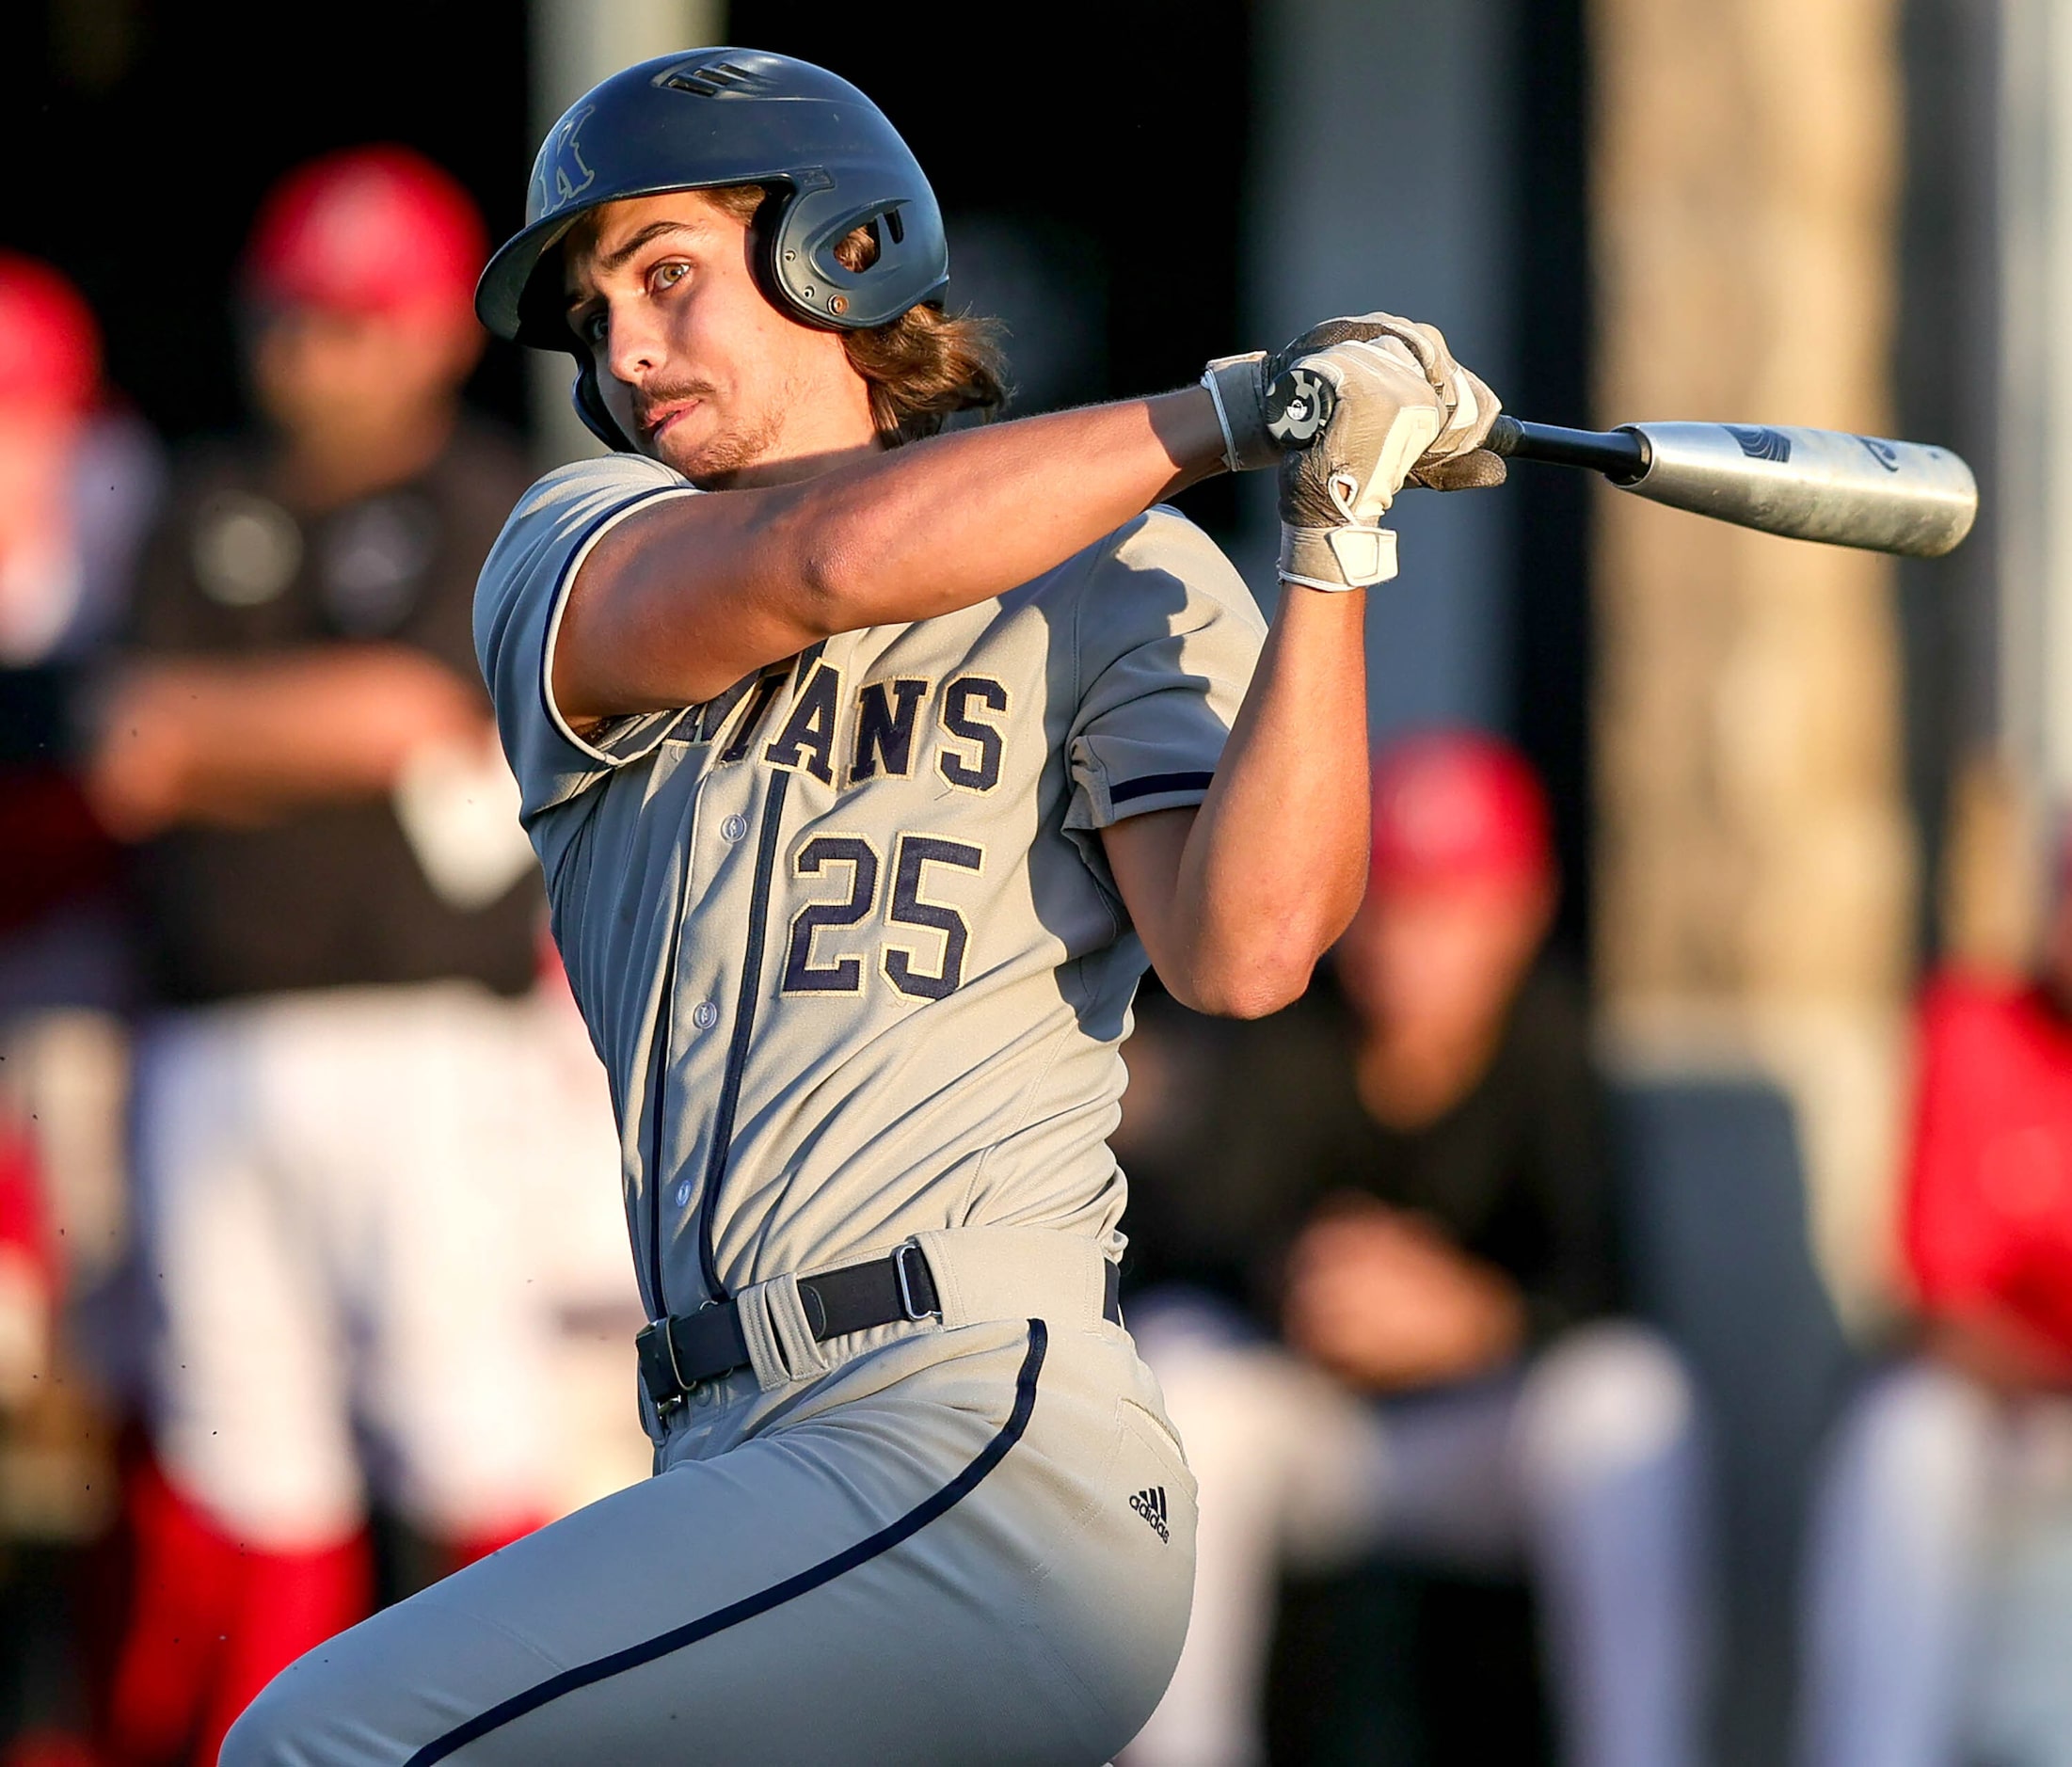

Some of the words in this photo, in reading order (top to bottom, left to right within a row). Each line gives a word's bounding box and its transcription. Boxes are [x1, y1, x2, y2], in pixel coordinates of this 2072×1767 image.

[539, 103, 596, 219] K
[779, 831, 987, 1004] 25
[1129, 1495, 1170, 1544] adidas
